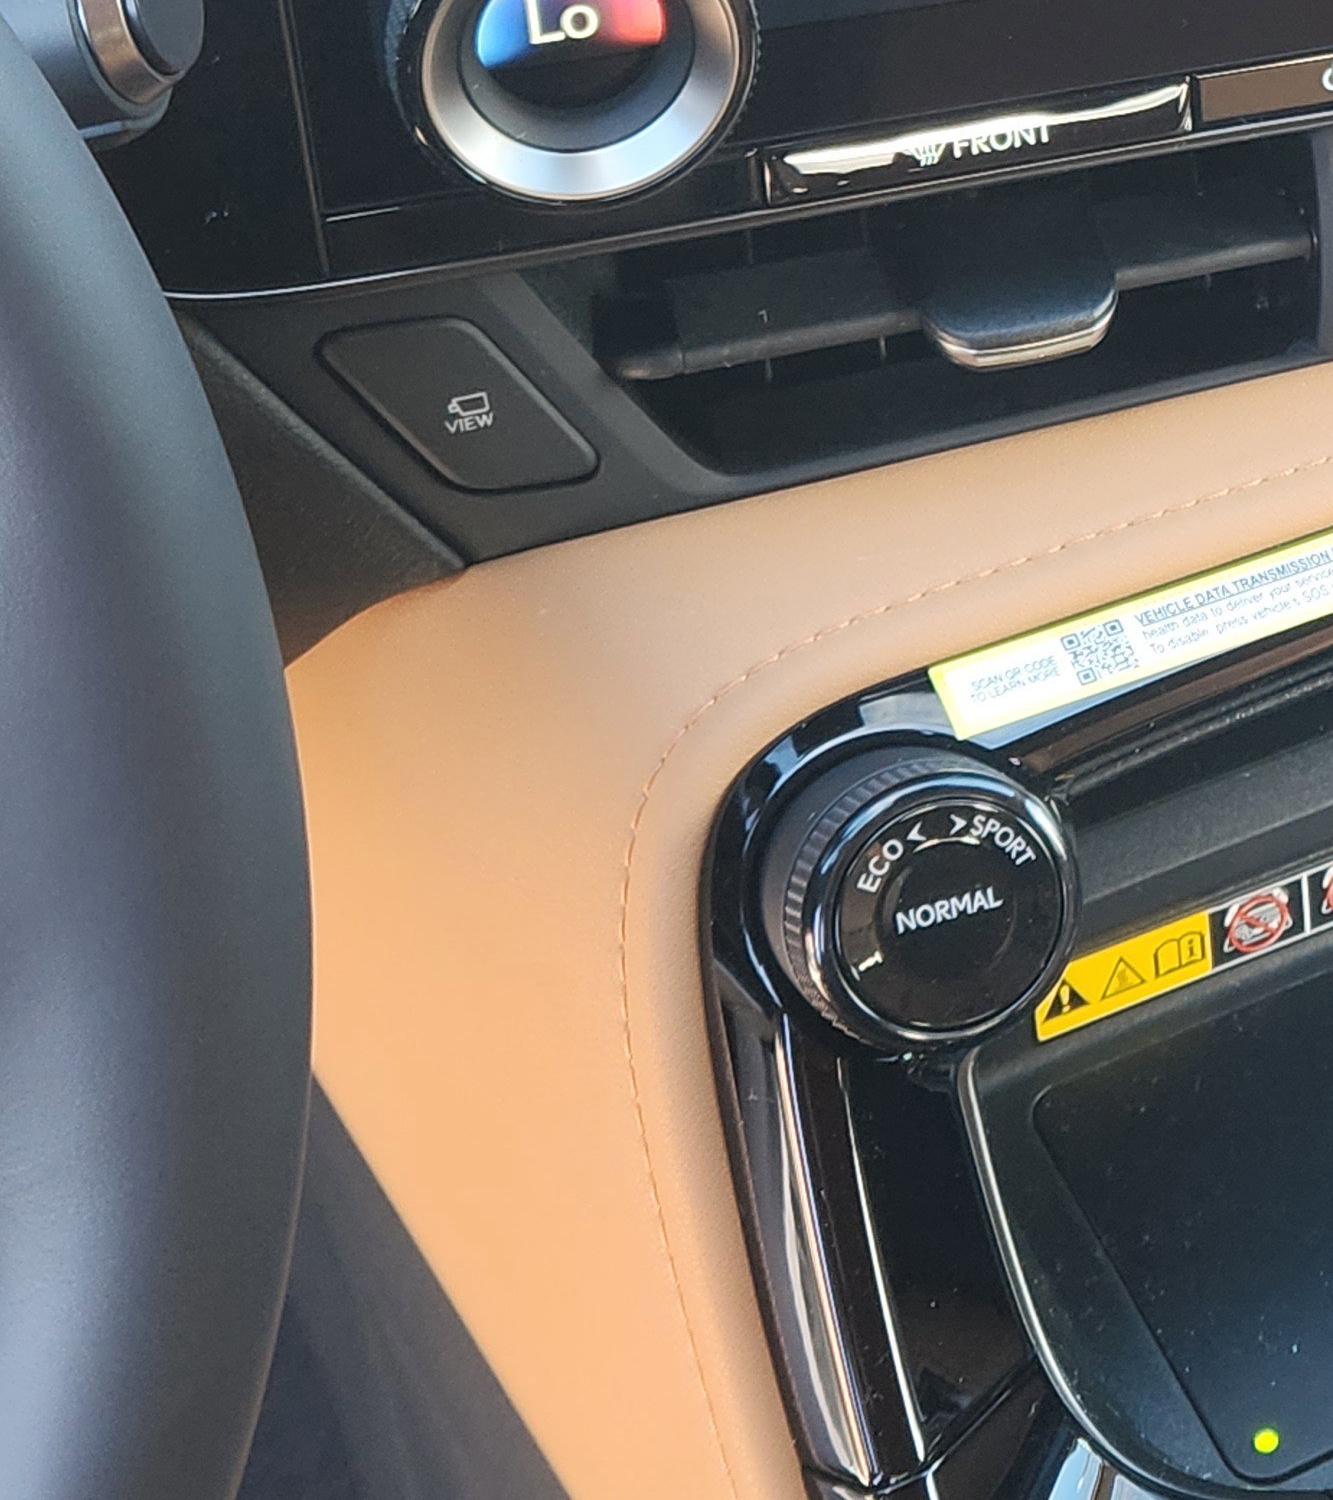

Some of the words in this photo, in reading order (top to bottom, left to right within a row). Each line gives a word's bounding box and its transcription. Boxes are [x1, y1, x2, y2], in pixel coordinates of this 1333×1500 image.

[951, 118, 1051, 159] FRONT
[443, 411, 494, 434] VIEW
[1134, 596, 1193, 626] VEHICLE
[1193, 583, 1231, 606] DATA
[1231, 549, 1331, 593] TRANSMISSION
[970, 672, 1004, 691] SCAN
[969, 814, 1037, 866] SPORT
[856, 838, 905, 893] ECO
[895, 886, 1004, 935] NORMAL
